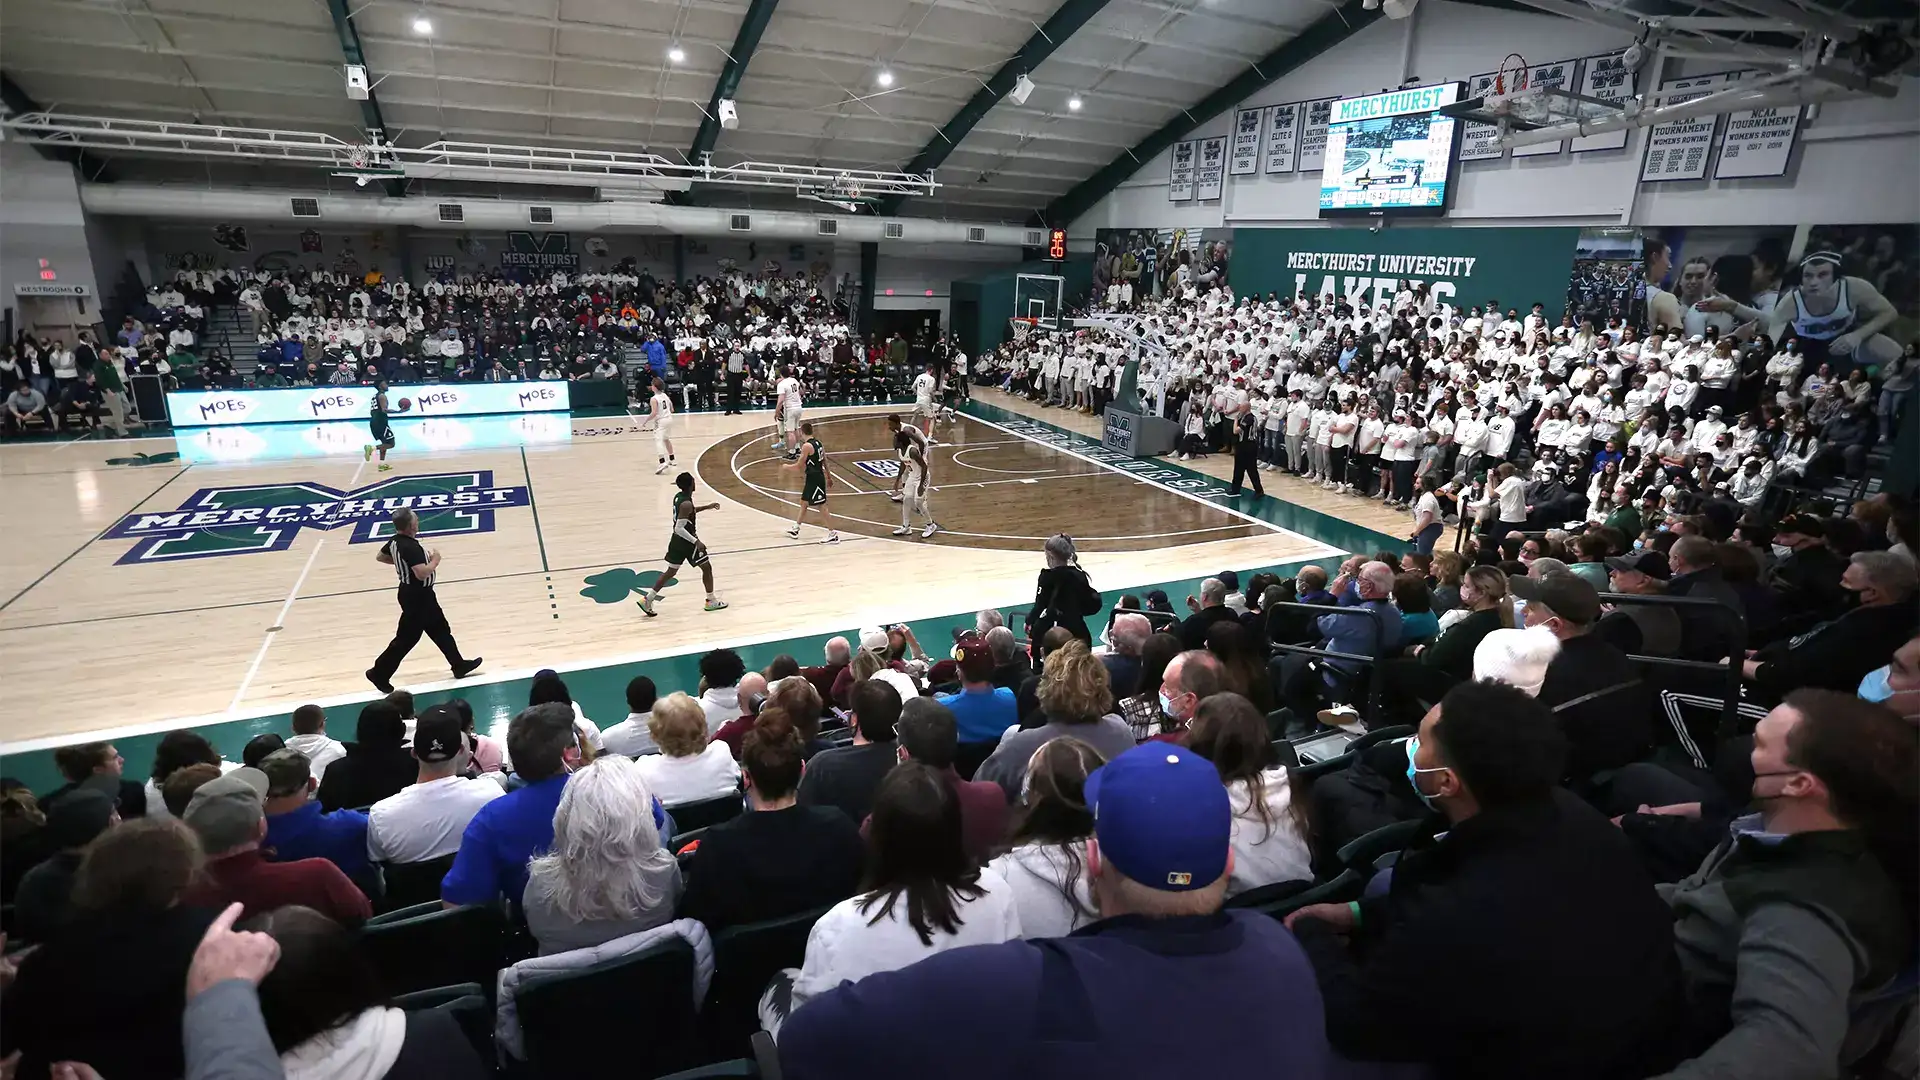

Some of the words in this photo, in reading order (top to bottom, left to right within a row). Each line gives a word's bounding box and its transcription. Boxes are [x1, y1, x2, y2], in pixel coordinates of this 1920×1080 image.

[1596, 89, 1616, 99] NCAA
[1340, 88, 1444, 119] MERCYHURST
[1751, 108, 1777, 118] NCAA
[1731, 116, 1796, 130] TOURNAMENT
[1466, 130, 1498, 139] WRESTLIN
[1655, 123, 1712, 136] TOURNAMENT
[1761, 129, 1791, 138] ROWING
[1237, 135, 1252, 144] ELITE
[1271, 131, 1288, 141] ELITE
[1682, 135, 1709, 143] ROWING
[502, 253, 578, 265] MERCYHURST
[1287, 252, 1375, 273] MERCYHURST
[1378, 254, 1476, 277] UNIVERSITY
[1147, 260, 1155, 273] 13
[1295, 273, 1457, 318] LAKES
[130, 488, 515, 531] MERCYHURST
[269, 508, 397, 524] UNIVERSITY
